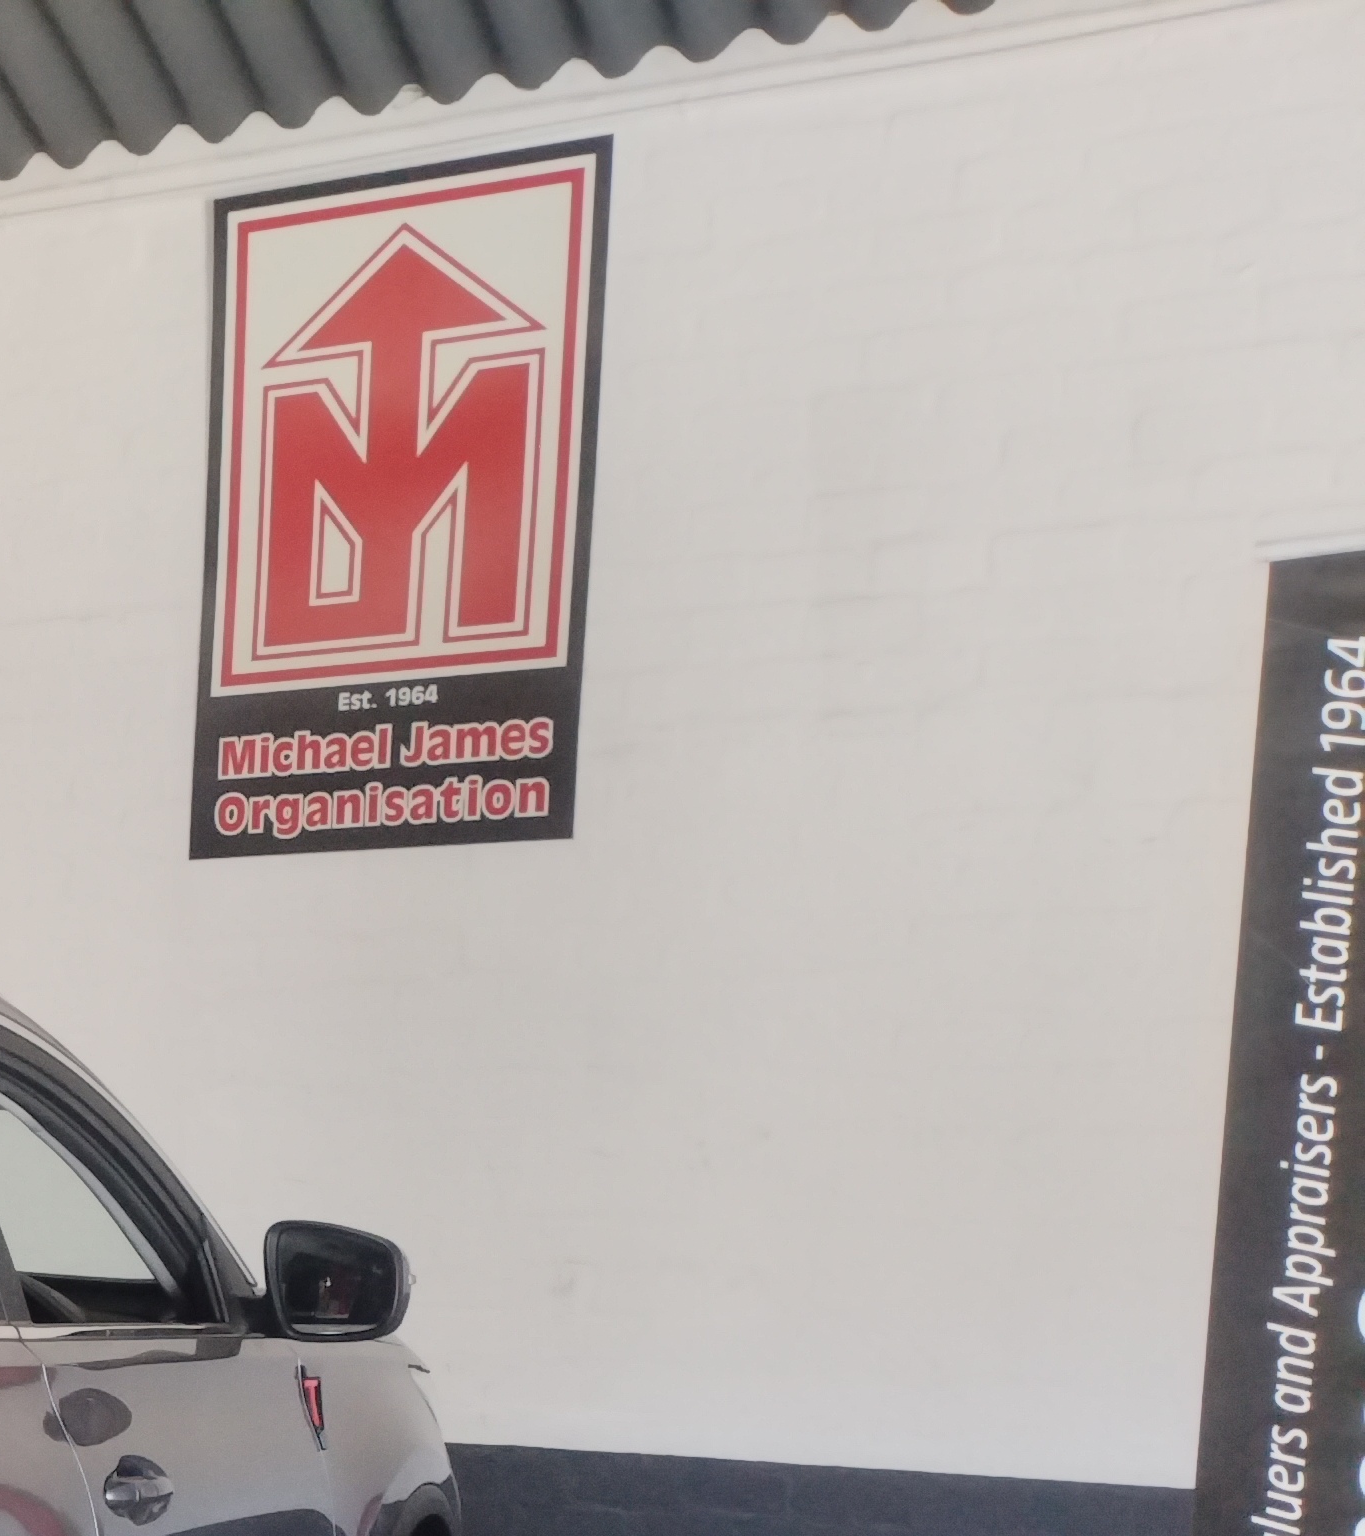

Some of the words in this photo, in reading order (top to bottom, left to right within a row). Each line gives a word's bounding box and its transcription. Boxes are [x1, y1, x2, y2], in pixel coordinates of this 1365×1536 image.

[338, 691, 377, 711] Est.
[385, 684, 438, 708] 1964
[1319, 636, 1365, 751] 1964
[217, 722, 393, 781] Michael
[400, 717, 554, 767] James
[214, 775, 550, 839] Organisation
[1295, 767, 1364, 1032] Established
[1272, 1072, 1338, 1317] Appraisers
[1267, 1322, 1317, 1415] and
